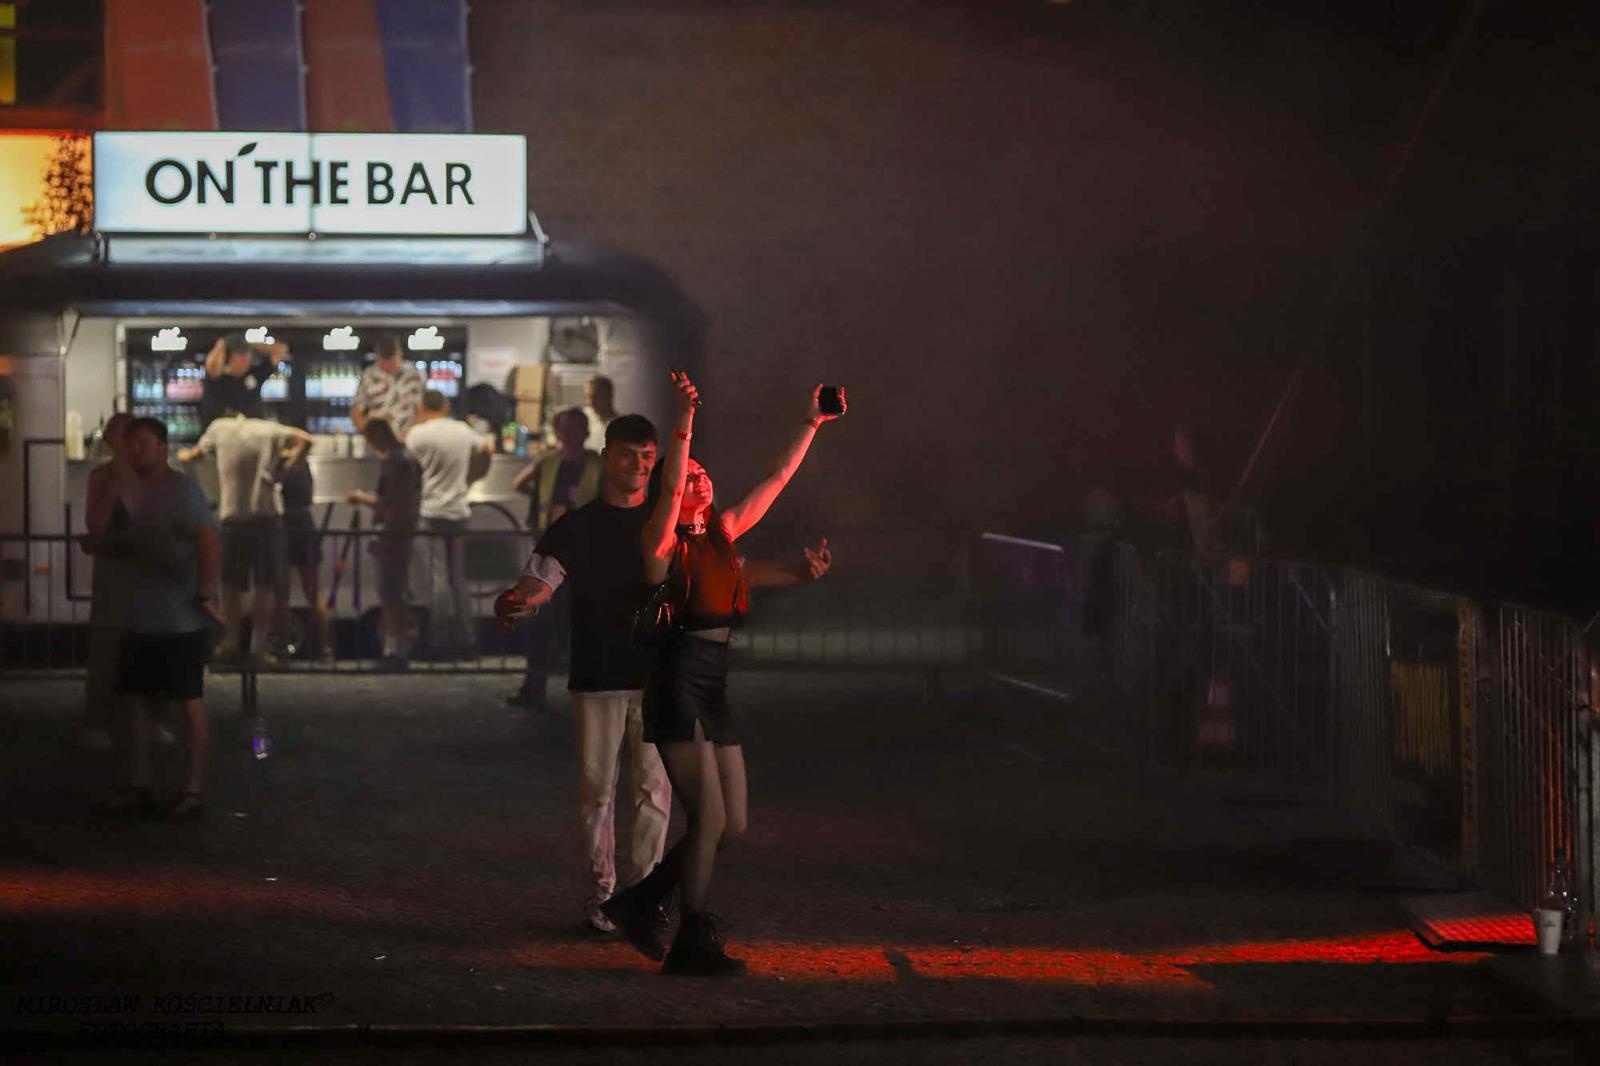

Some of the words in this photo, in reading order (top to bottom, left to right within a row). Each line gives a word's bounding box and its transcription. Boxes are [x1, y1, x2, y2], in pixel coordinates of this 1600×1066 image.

[146, 159, 235, 204] ON
[254, 160, 348, 204] THE
[366, 161, 475, 204] BAR
